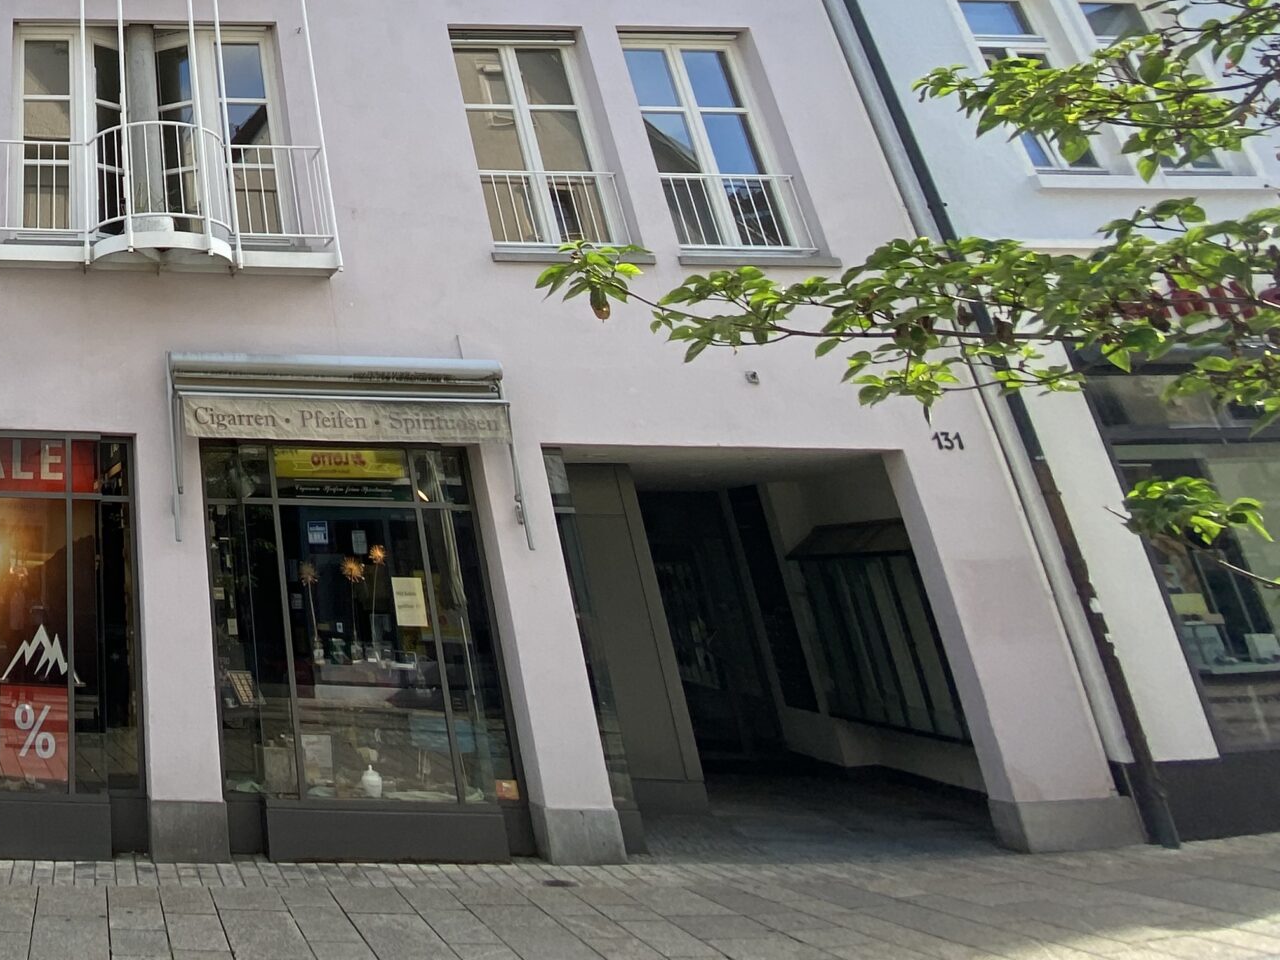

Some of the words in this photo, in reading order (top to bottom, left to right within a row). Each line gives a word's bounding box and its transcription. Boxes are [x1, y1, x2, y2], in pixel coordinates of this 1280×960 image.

[193, 406, 277, 430] Cigarren
[298, 409, 367, 429] Pfeifen
[389, 411, 500, 433] Spirituosen
[931, 431, 964, 450] 131
